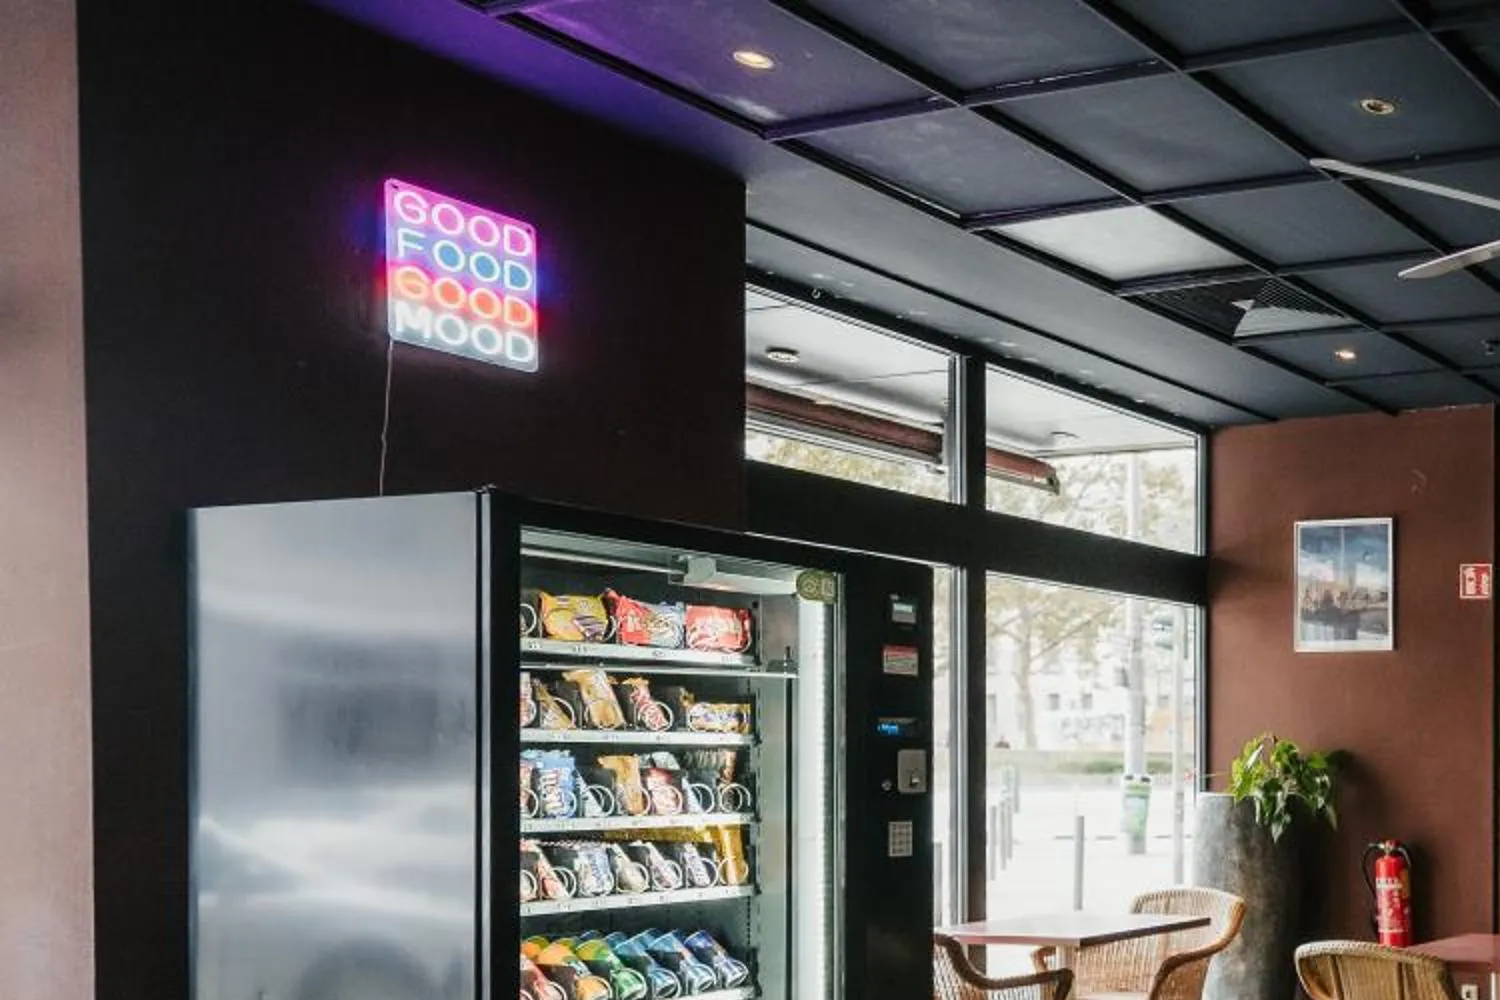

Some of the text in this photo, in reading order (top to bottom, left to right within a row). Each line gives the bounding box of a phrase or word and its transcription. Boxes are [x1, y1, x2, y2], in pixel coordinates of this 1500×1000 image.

[393, 190, 532, 257] GOOD
[397, 227, 532, 290] FOOD
[394, 265, 533, 327] GOOD
[394, 300, 534, 362] MOOD
